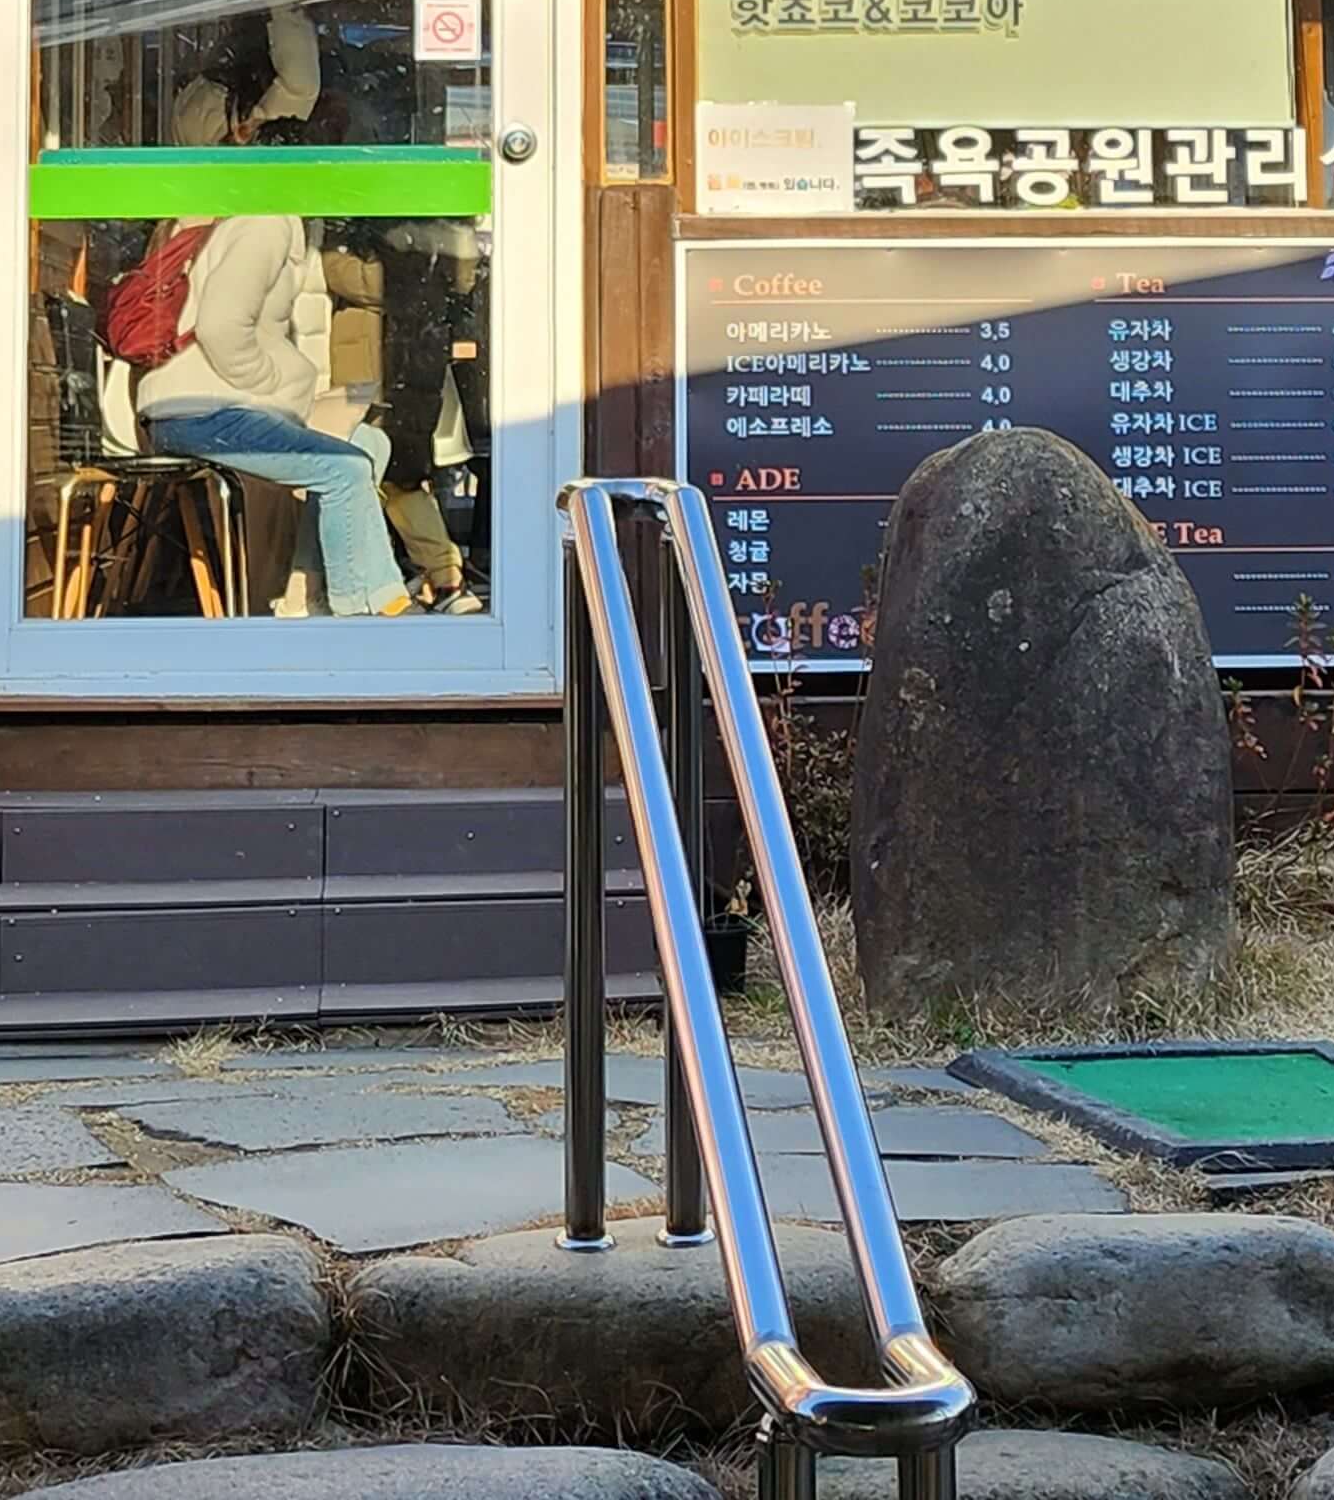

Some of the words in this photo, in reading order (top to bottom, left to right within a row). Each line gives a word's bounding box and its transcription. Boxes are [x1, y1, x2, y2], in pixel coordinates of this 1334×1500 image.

[732, 274, 824, 297] Coffee
[1116, 272, 1166, 295] Tea
[726, 320, 832, 343] 아메리카노
[979, 322, 1011, 341] 3.5
[1108, 318, 1173, 341] 유자차
[726, 352, 872, 374] ICE아메리카노
[979, 354, 1011, 373] 4.0
[1109, 350, 1173, 373] 생강차
[726, 385, 812, 407] 카페라떼
[980, 386, 1012, 406] 4.0
[1110, 381, 1174, 404] 대추차
[725, 416, 834, 438] 에소프레소
[982, 419, 1012, 432] 40
[1110, 412, 1175, 436] 유자차
[1179, 414, 1219, 433] ICE
[1111, 445, 1176, 469] 생강차
[1183, 447, 1223, 466] ICE
[735, 468, 802, 491] ADE
[1113, 476, 1177, 499] 대추차
[1183, 480, 1223, 498] ICE
[727, 509, 771, 531] 레몬
[1173, 521, 1225, 545] Tea
[728, 540, 771, 563] 청귤
